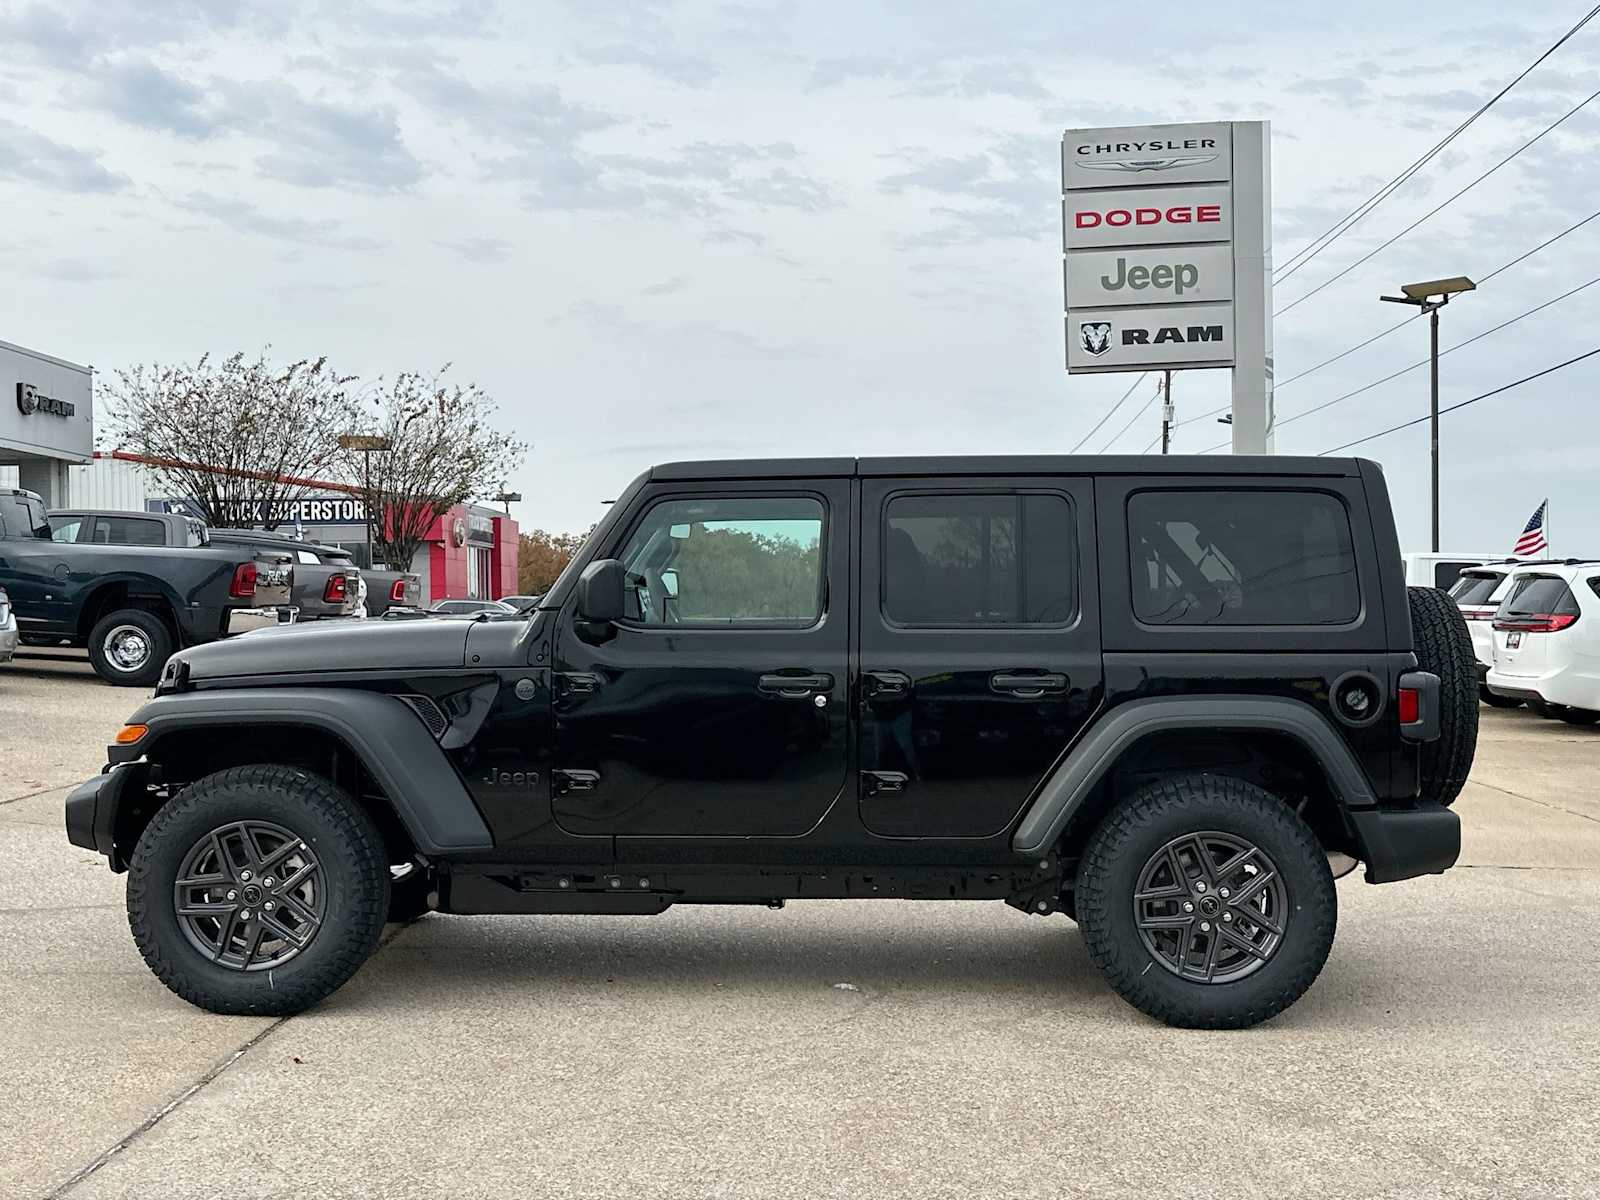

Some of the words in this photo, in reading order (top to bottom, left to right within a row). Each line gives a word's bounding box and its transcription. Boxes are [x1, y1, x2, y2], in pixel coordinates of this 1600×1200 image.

[1077, 139, 1216, 155] CHRYSLER
[1075, 205, 1221, 229] DODGE
[1101, 257, 1199, 295] Jeep
[1122, 325, 1223, 345] RAM
[37, 395, 75, 417] RAM
[482, 767, 540, 788] Jeep
